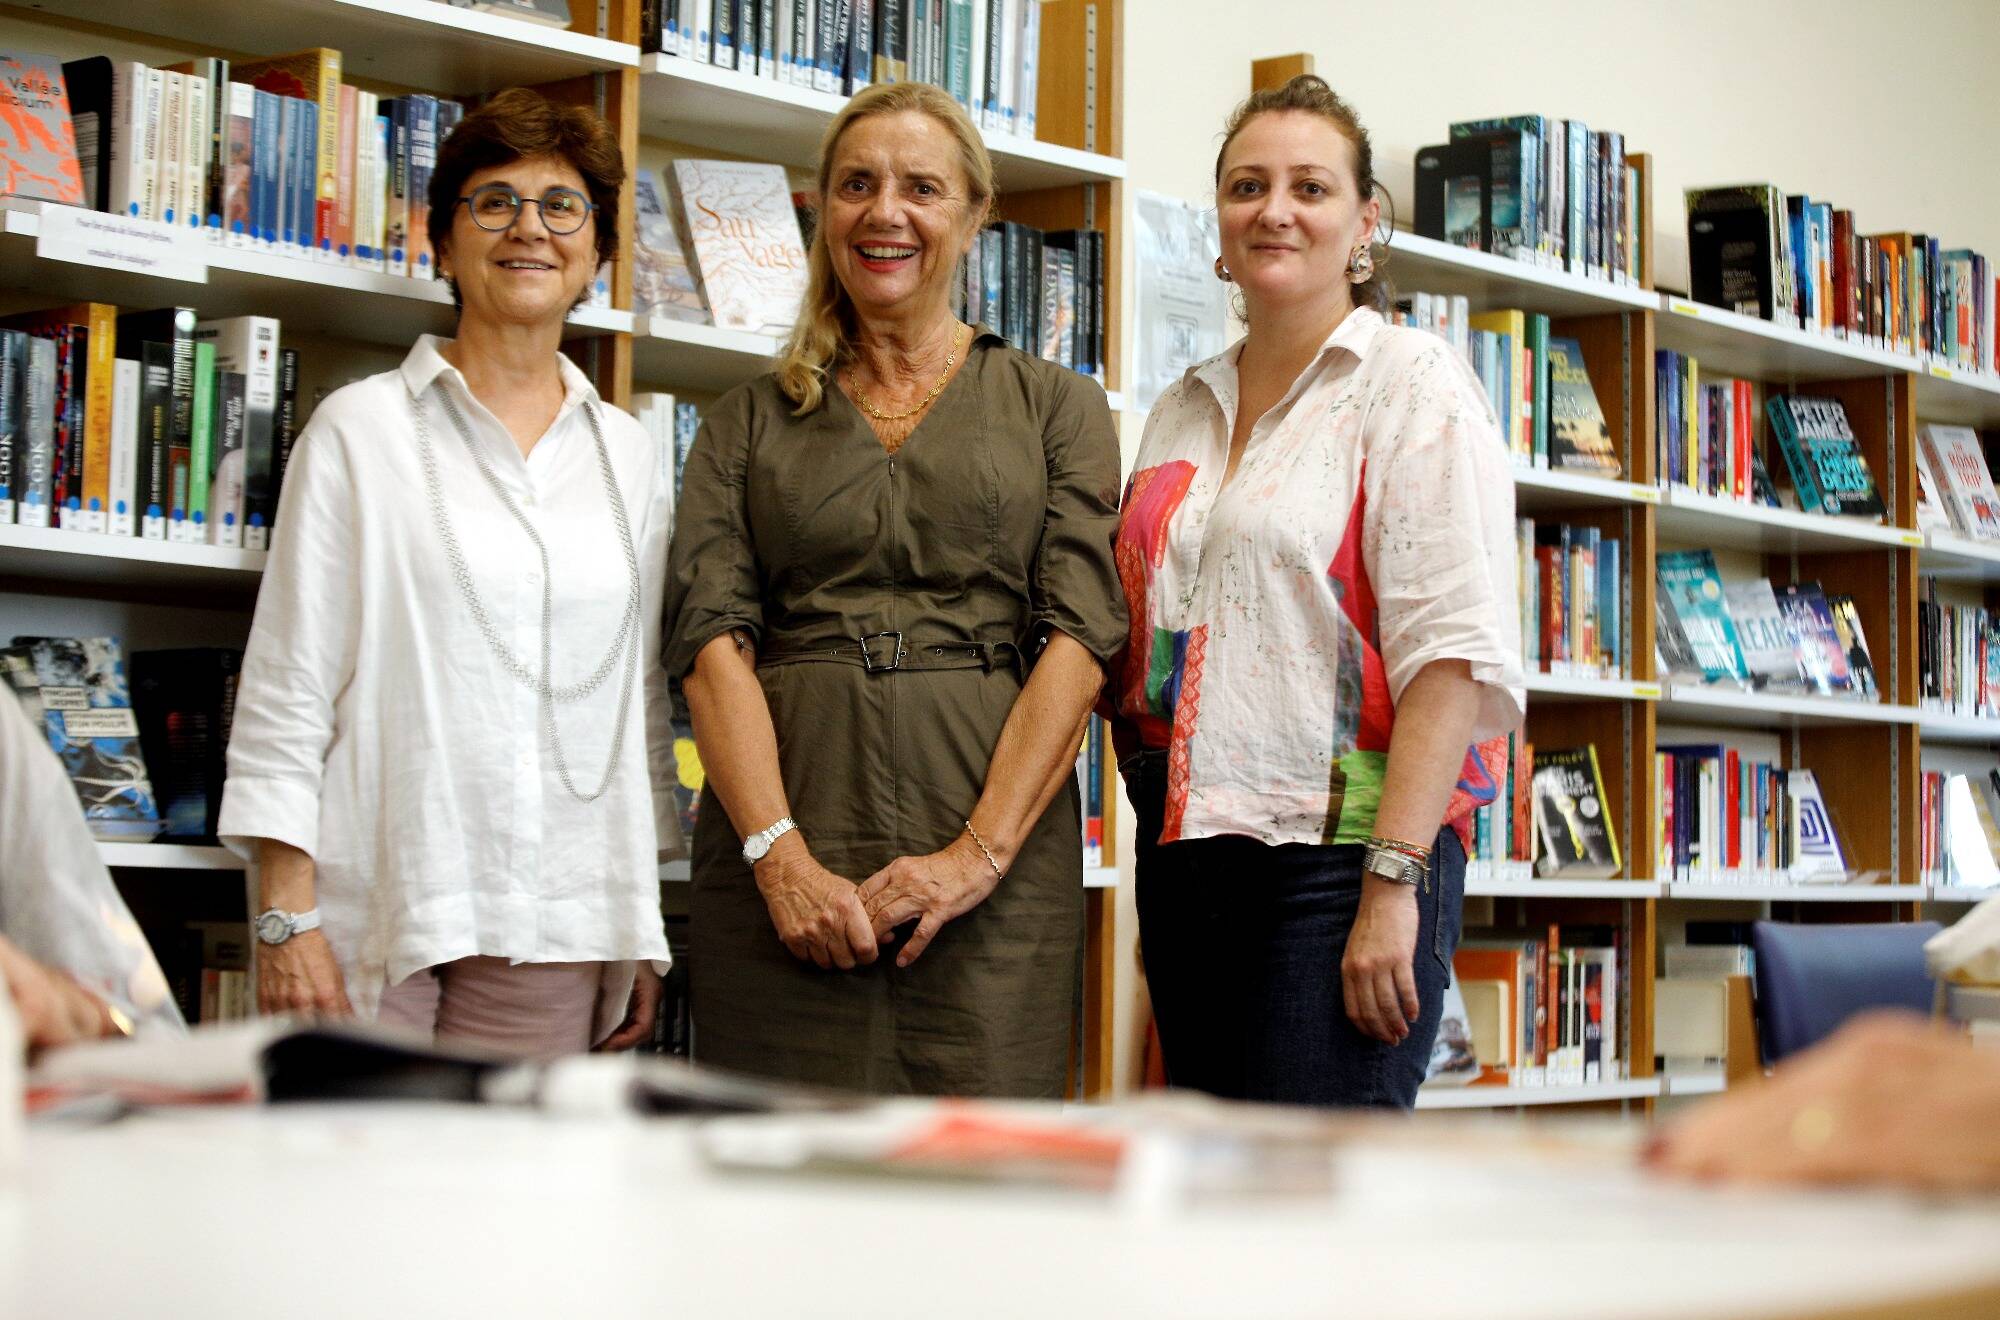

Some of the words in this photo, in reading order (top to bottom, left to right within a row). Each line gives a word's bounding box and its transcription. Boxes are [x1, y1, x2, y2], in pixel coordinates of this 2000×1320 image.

[1788, 399, 1845, 422] PETER
[1797, 420, 1853, 440] JAMES
[1552, 752, 1585, 764] FOLEY
